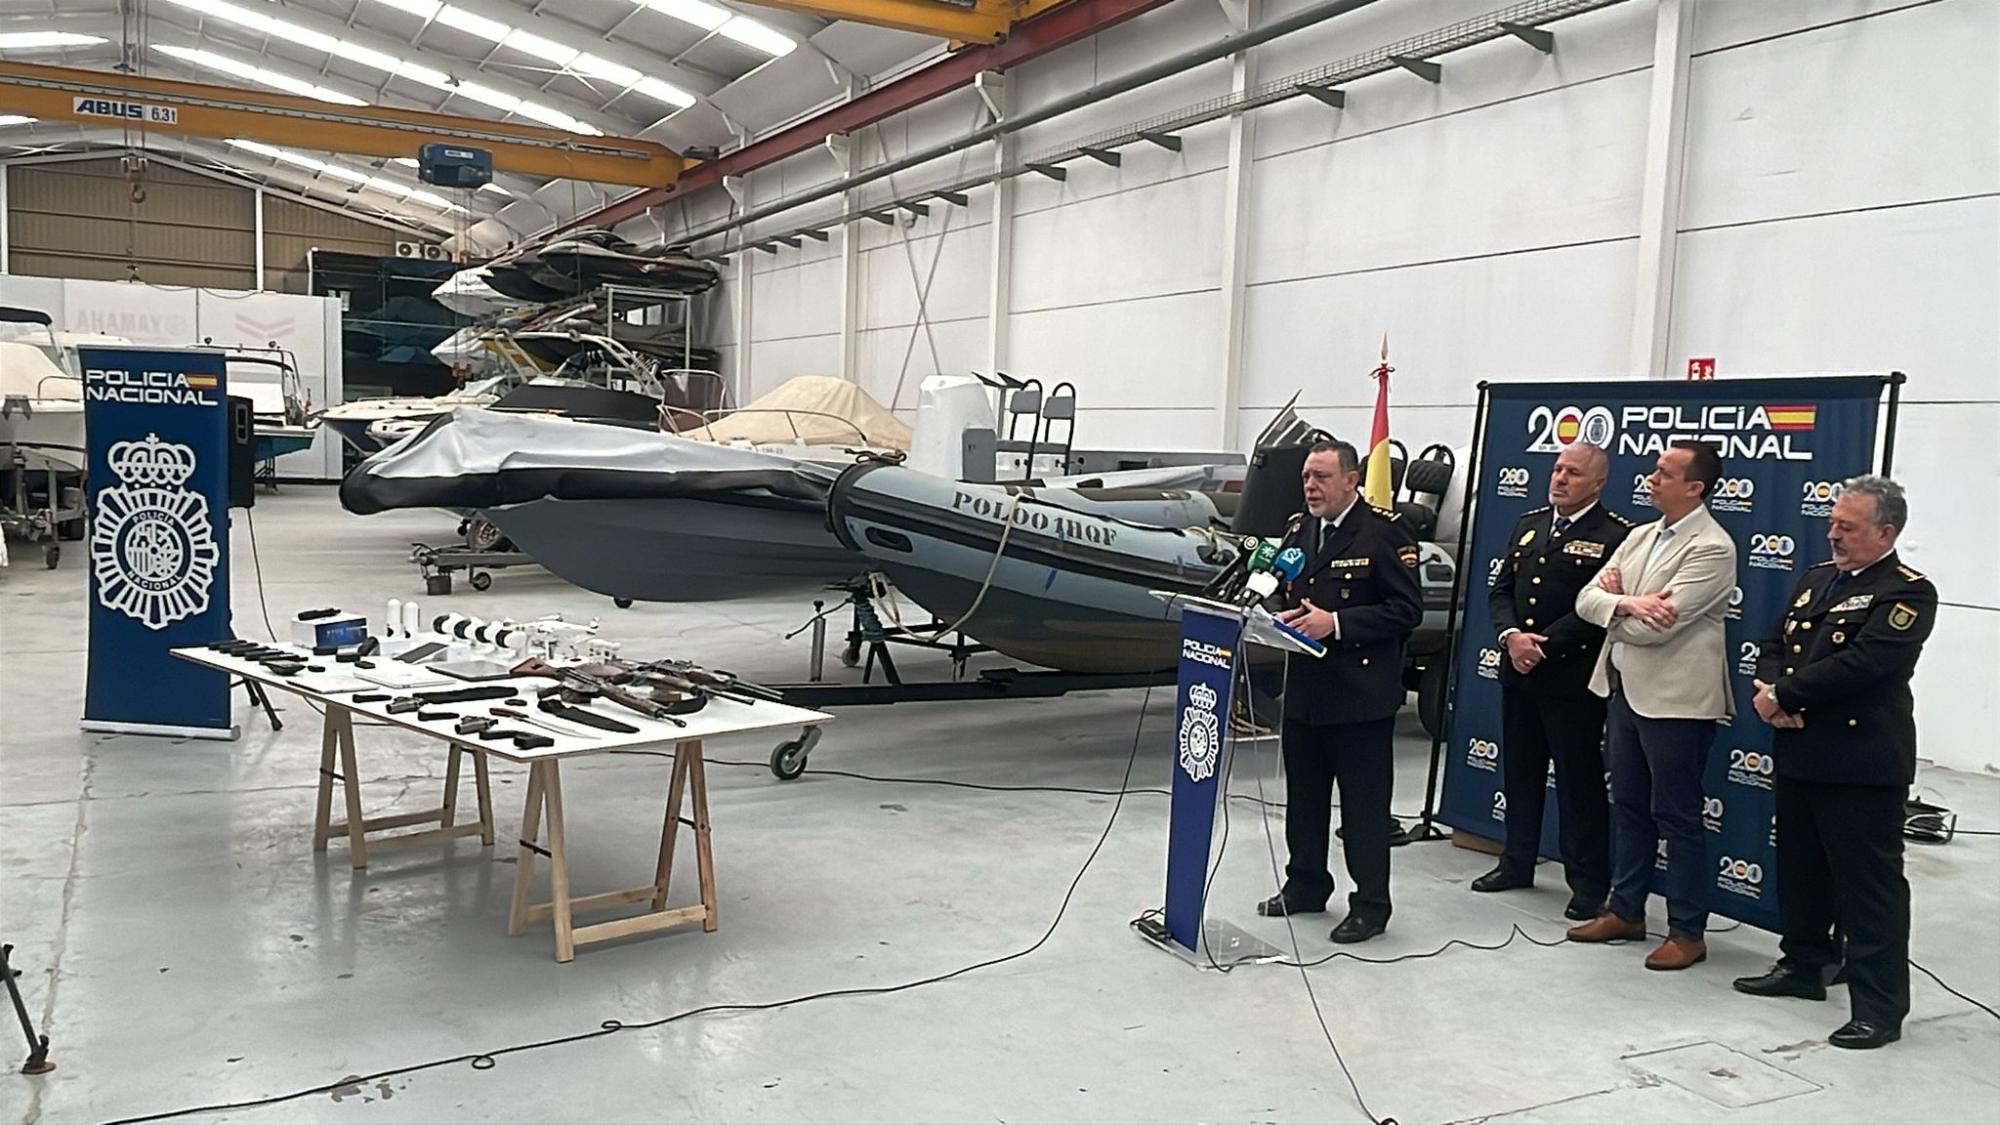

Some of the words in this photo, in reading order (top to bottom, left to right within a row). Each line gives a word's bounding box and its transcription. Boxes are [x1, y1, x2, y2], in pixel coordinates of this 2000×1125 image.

[76, 100, 143, 118] ABUS
[86, 386, 218, 406] NACIONAL
[1499, 468, 1530, 485] 200
[1713, 478, 1754, 498] 200
[1751, 533, 1795, 556] 200
[126, 570, 183, 590] NACIONAL
[1469, 738, 1499, 759] 200
[1730, 749, 1774, 775] 200
[1719, 856, 1763, 883] 200
